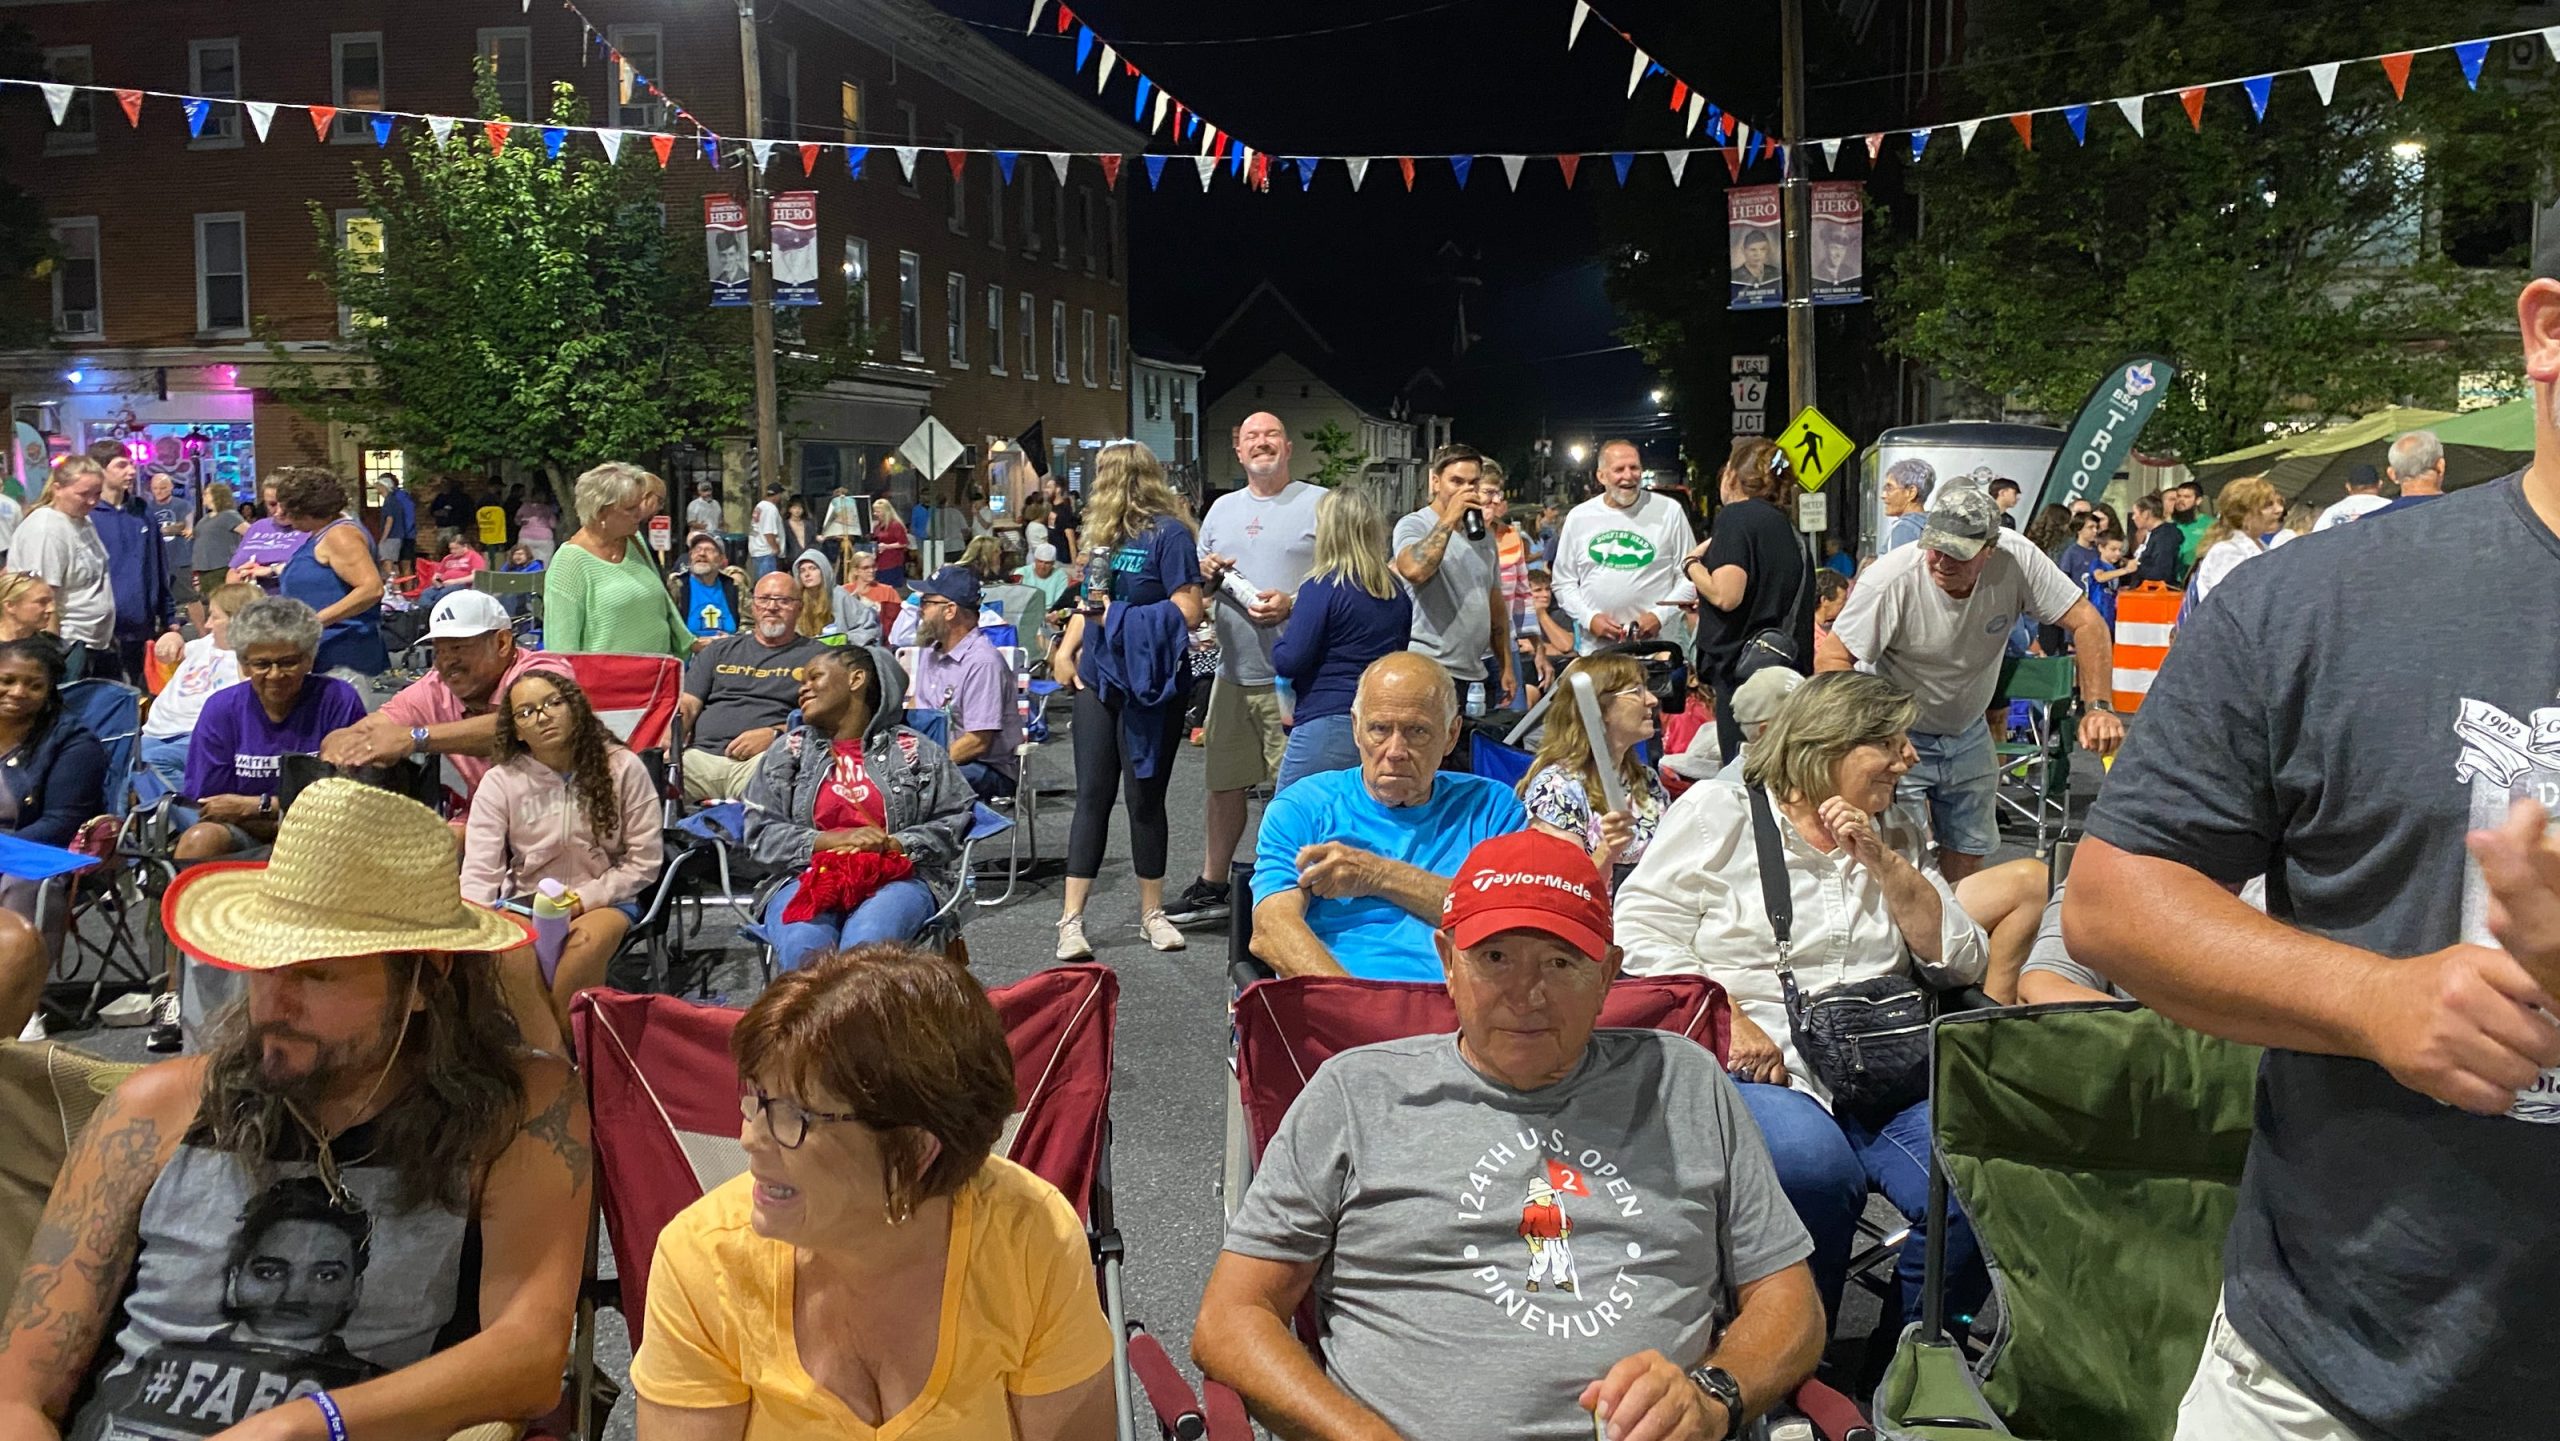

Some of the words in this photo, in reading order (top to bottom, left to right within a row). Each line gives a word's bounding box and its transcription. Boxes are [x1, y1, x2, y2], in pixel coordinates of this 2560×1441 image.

[1732, 203, 1777, 219] HERO
[1815, 199, 1860, 213] HERO
[710, 211, 743, 223] HERO
[773, 208, 813, 221] HERO
[1736, 360, 1765, 371] WEST
[1739, 383, 1761, 402] 16
[2111, 388, 2139, 411] BSA
[1735, 415, 1763, 430] JCT
[716, 664, 791, 678] carhartt
[2479, 709, 2521, 740] 1902
[235, 757, 271, 768] MITH
[236, 768, 271, 778] AMILY
[1472, 869, 1592, 901] TaylorMade
[1458, 1142, 1516, 1221] 124TH
[1516, 1128, 1570, 1156] U.S.
[1579, 1149, 1643, 1218] OPEN
[1560, 1169, 1578, 1191] 2
[1472, 1265, 1640, 1339] PINEHURST
